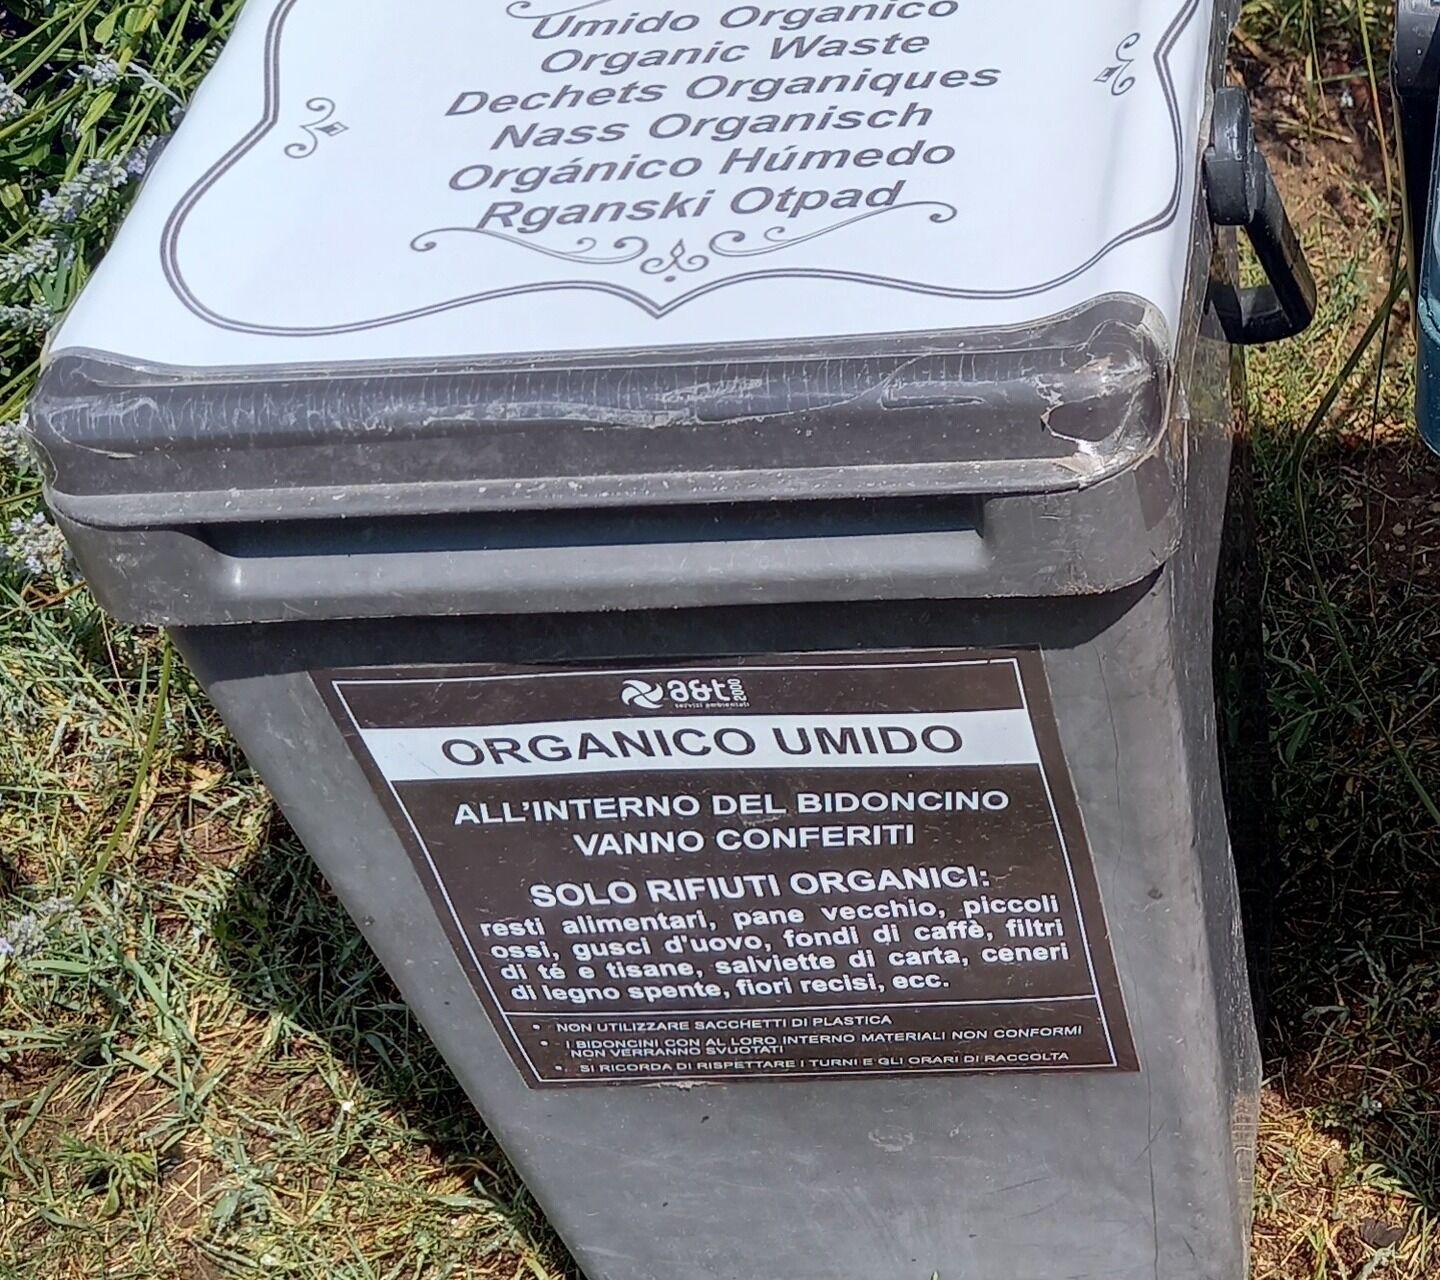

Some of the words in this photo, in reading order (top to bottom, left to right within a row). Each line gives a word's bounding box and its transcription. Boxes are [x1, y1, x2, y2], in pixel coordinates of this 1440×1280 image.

[531, 10, 700, 40] Umido
[540, 40, 749, 76] Organic
[769, 32, 930, 61] Waste
[445, 80, 668, 117] Dechets
[685, 65, 1002, 103] Organiques
[490, 121, 629, 151] Nass
[648, 102, 933, 142] Organisch
[448, 155, 702, 194] Orgánico
[719, 139, 955, 175] Húmedo
[475, 191, 711, 232] Rganski
[729, 180, 905, 219] Otpad
[667, 679, 730, 702] a&t
[727, 678, 747, 702] 2000
[440, 727, 757, 766] ORGANICO
[772, 722, 964, 757] UMIDO
[711, 791, 786, 817] DEL
[797, 789, 1009, 814] BIDONCINO
[573, 830, 704, 857] VANNO
[715, 824, 914, 853] CONFERITI
[529, 880, 637, 908] SOLO
[645, 874, 781, 902] RIFIUTI
[790, 866, 990, 895] ORGANICI:
[479, 918, 545, 937] resti
[562, 910, 717, 935] alimentari,
[732, 908, 804, 930] pane
[821, 899, 946, 921] vecchio,
[963, 894, 1059, 918] piccoli
[490, 941, 560, 961] ossi,
[572, 937, 651, 961] gusci
[664, 935, 772, 954] d'uovo,
[783, 926, 859, 948] fondi
[872, 924, 900, 944] di
[914, 920, 993, 942] caffè,
[1005, 919, 1063, 938] filtri
[500, 964, 528, 980] di
[578, 966, 595, 979] e
[605, 961, 703, 979] tisane,
[714, 954, 836, 975] salviette
[849, 949, 875, 968] di
[888, 947, 969, 966] carta,
[981, 942, 1069, 963] ceneri
[511, 984, 537, 1001] di
[541, 981, 620, 1003] legno
[627, 980, 731, 1003] spente,
[735, 977, 792, 996] fiori
[800, 973, 885, 993] recisi,
[892, 973, 950, 990] ecc.
[557, 1023, 592, 1033] NON
[597, 1021, 690, 1032] UTILIZZARE
[694, 1019, 786, 1030] SACCHETTI
[791, 1018, 807, 1028] DI
[813, 1015, 892, 1026] PLASTICA
[576, 1039, 658, 1049] BIDONCINI
[664, 1038, 700, 1047] CON
[705, 1037, 726, 1046] AL
[731, 1035, 776, 1045] LORO
[782, 1034, 855, 1045] INTERNO
[861, 1032, 945, 1042] MATERIALI
[952, 1030, 987, 1040] NON
[993, 1026, 1081, 1038] CONFORMI
[571, 1049, 605, 1057] NON
[609, 1047, 700, 1057] VERRANNO
[705, 1044, 783, 1055] SVUOTATI
[580, 1064, 595, 1072] SI
[599, 1062, 672, 1072] RICORDA
[677, 1061, 693, 1070] DI
[697, 1059, 795, 1069] RISPETTARE
[809, 1057, 857, 1067] TURNI
[863, 1057, 873, 1066] E
[878, 1056, 903, 1065] GLI
[908, 1055, 959, 1064] ORARI
[964, 1054, 979, 1063] DI
[985, 1052, 1068, 1063] RACCOLTA
